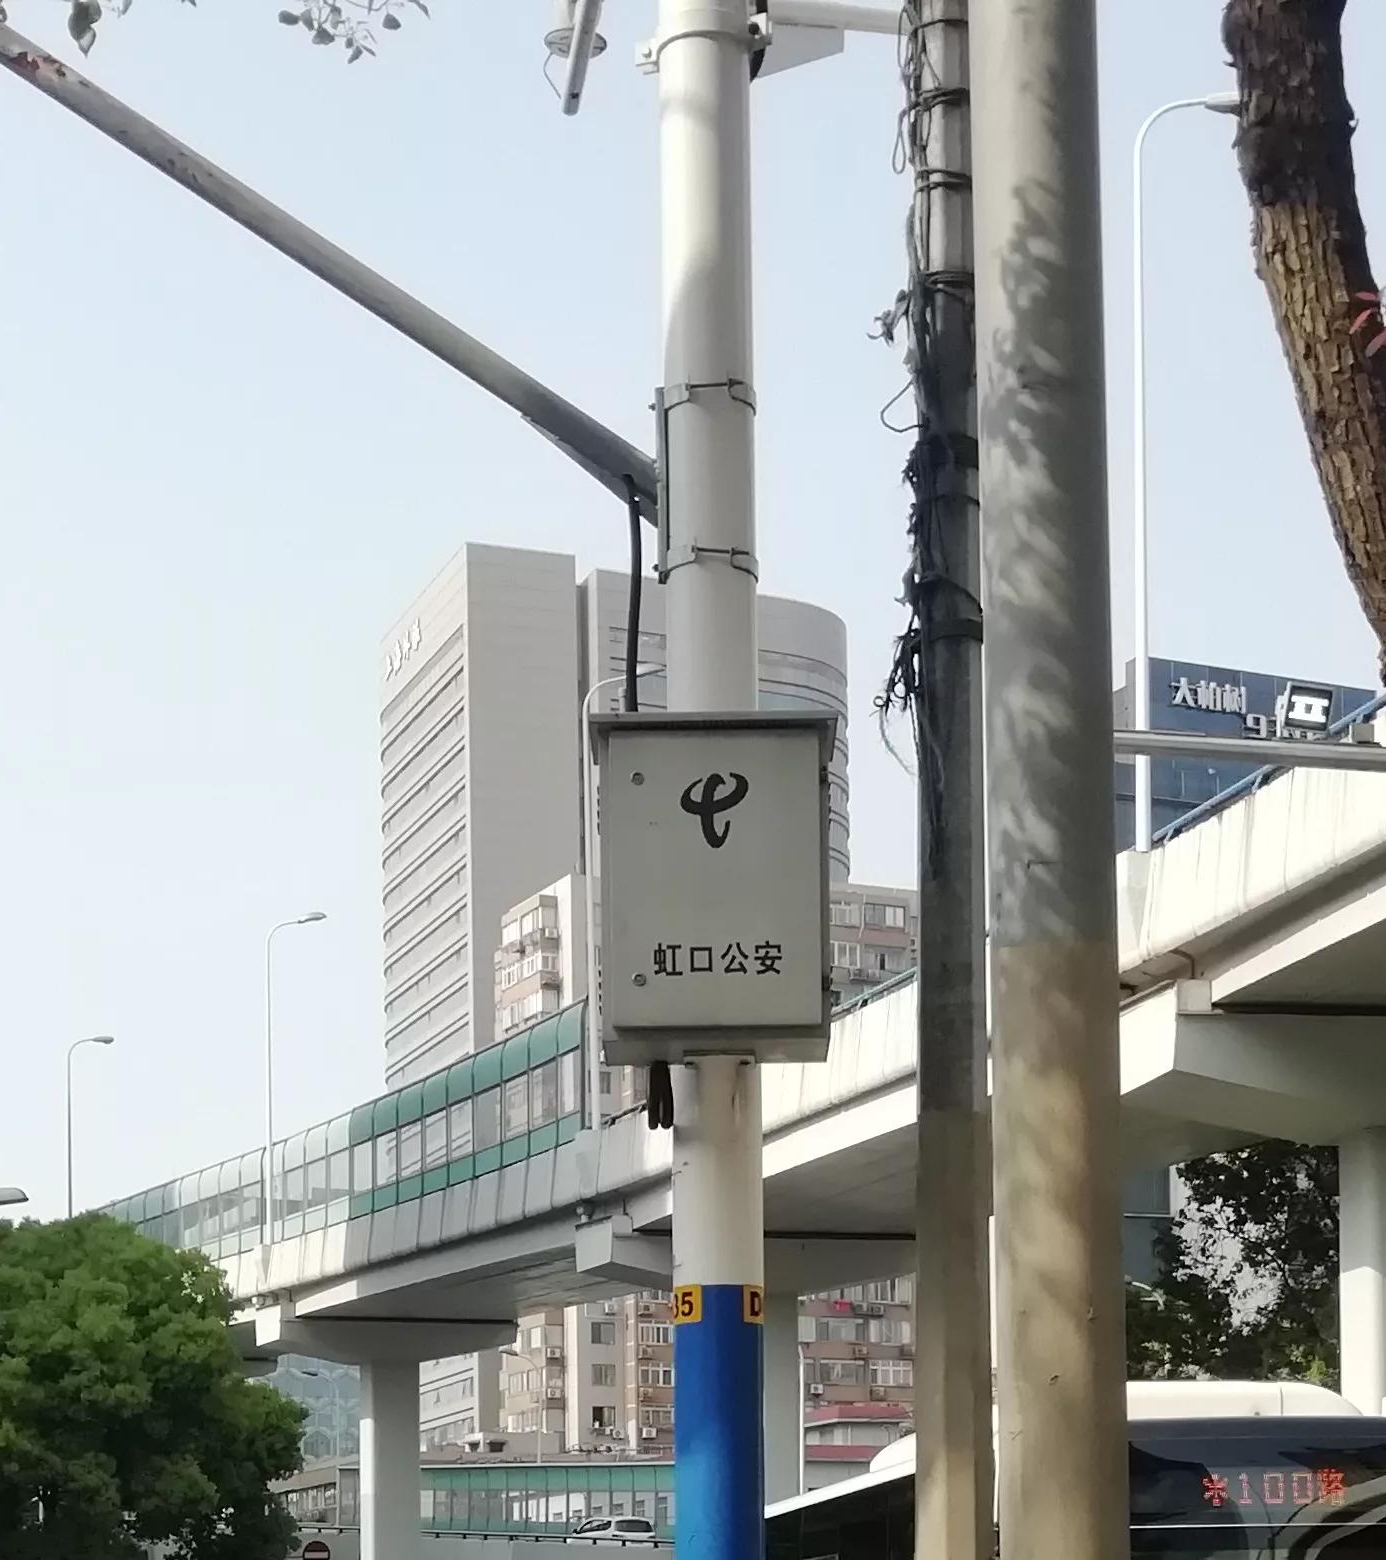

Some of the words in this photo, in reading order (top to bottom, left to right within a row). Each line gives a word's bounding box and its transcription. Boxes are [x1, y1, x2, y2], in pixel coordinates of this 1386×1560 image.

[1169, 676, 1247, 715] 大柏树
[653, 940, 783, 977] 虹口公安
